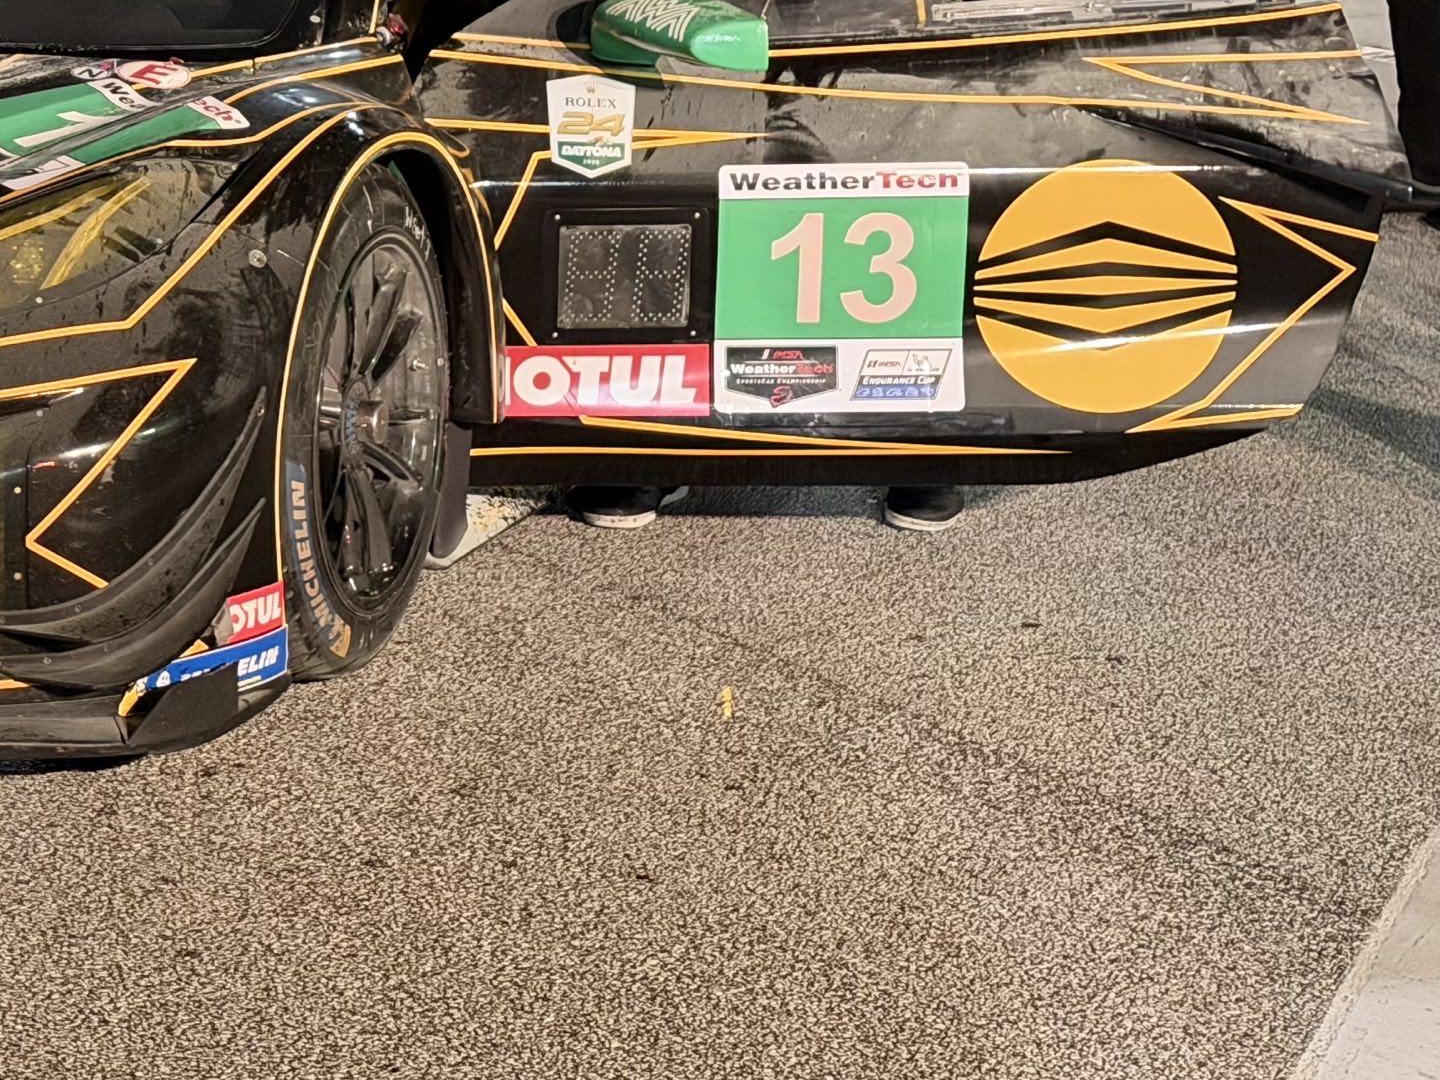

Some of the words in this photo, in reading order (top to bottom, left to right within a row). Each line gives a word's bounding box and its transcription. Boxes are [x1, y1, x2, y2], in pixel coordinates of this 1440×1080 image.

[565, 96, 617, 109] ROLEX
[557, 111, 626, 137] 24
[560, 144, 622, 158] DAYTONA
[729, 171, 960, 191] WeatherTech
[770, 212, 918, 324] 13
[505, 354, 697, 407] OTUL
[730, 363, 834, 375] WeatherTech
[291, 480, 334, 630] MICHELIN
[230, 591, 281, 634] OTUL
